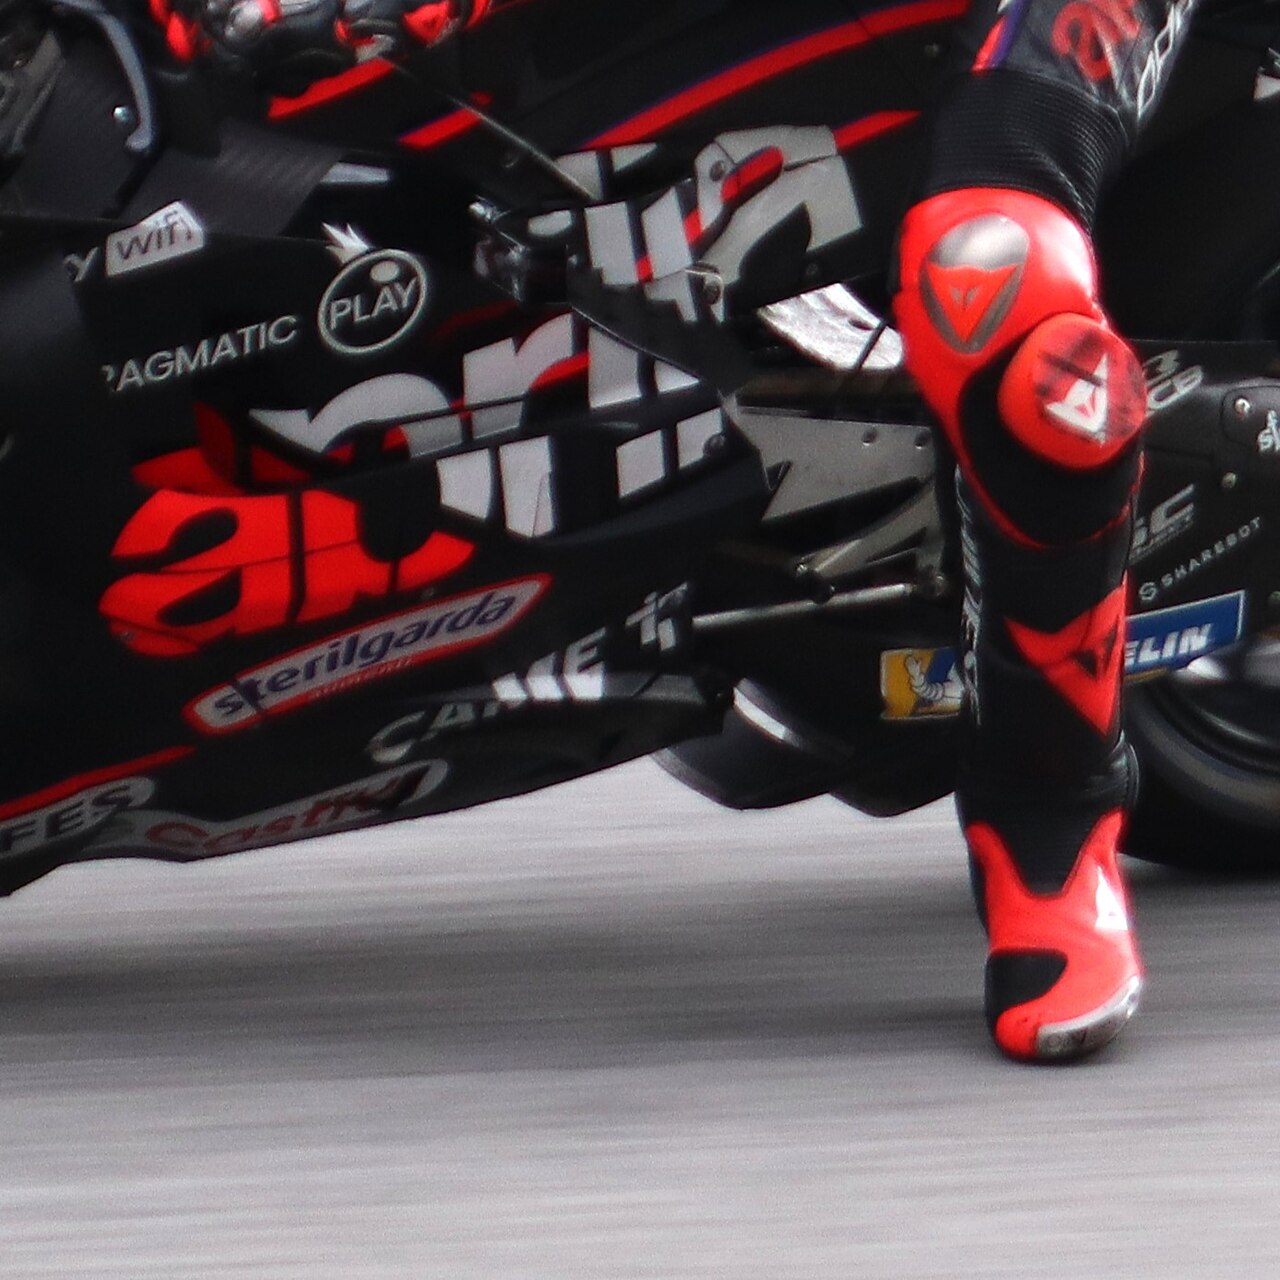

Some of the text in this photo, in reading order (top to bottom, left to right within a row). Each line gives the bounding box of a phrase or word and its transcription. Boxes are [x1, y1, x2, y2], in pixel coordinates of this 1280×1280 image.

[326, 275, 419, 332] PLAY
[1161, 515, 1261, 587] SHAREBOT
[214, 590, 518, 718] sterilgarda
